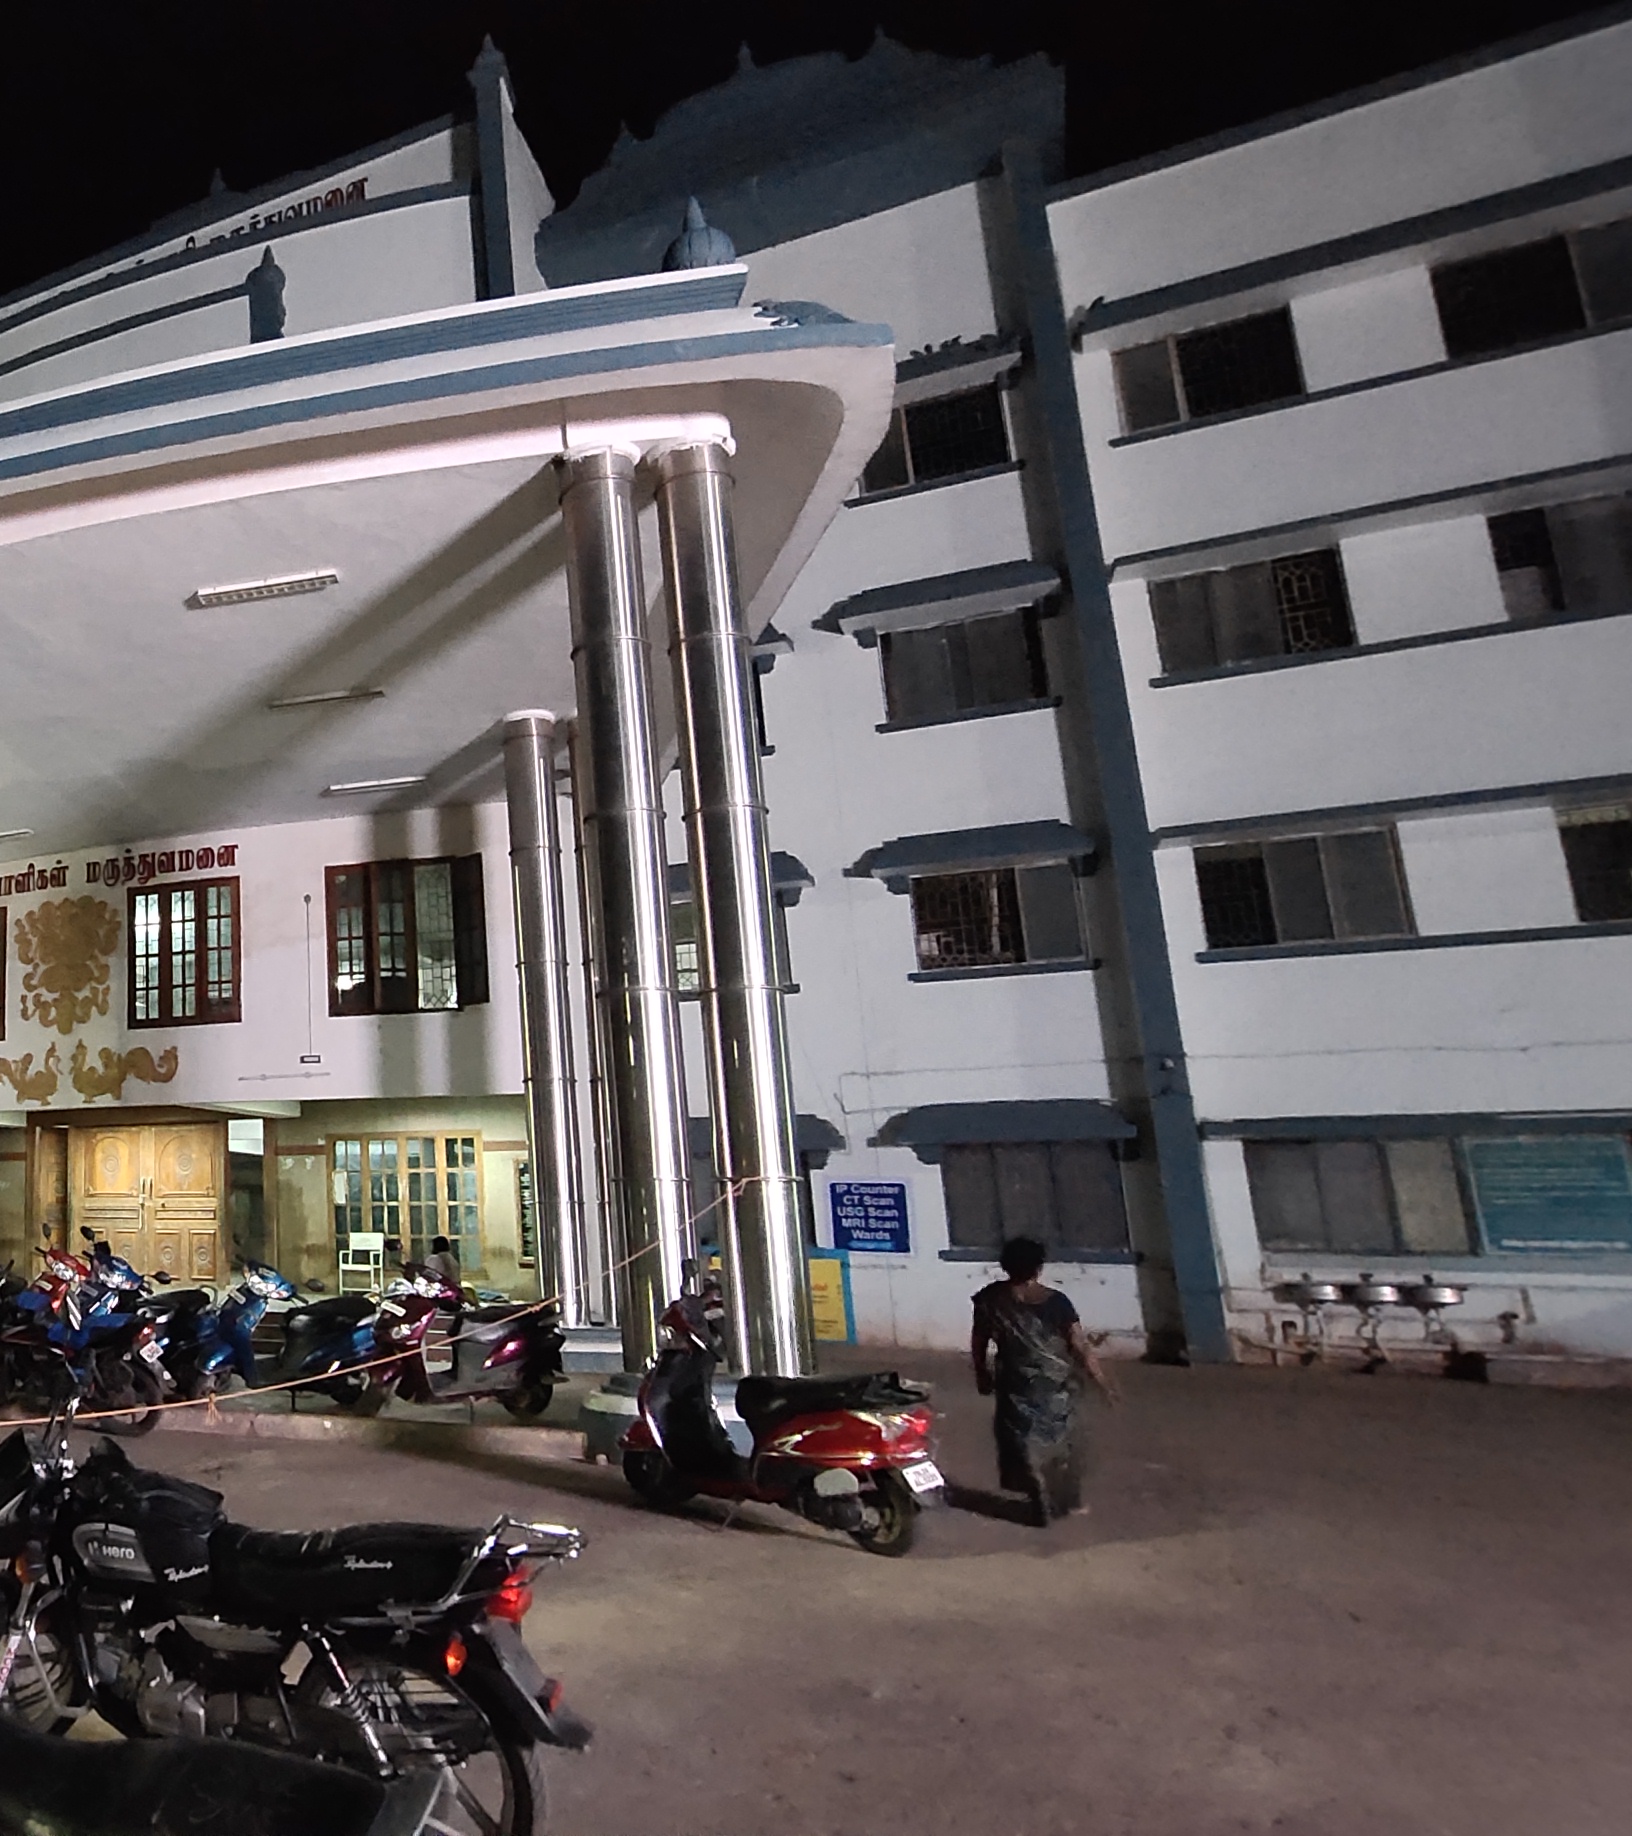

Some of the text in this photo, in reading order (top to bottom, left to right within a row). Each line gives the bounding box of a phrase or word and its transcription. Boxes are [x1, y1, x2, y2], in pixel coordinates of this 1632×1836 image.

[85, 844, 239, 887] மருத்துவமனை
[835, 1184, 900, 1194] IP Counter
[843, 1195, 895, 1206] CT Scan
[837, 1206, 899, 1218] USG Scan
[841, 1218, 900, 1229] MRI Scan
[851, 1229, 891, 1240] Wards
